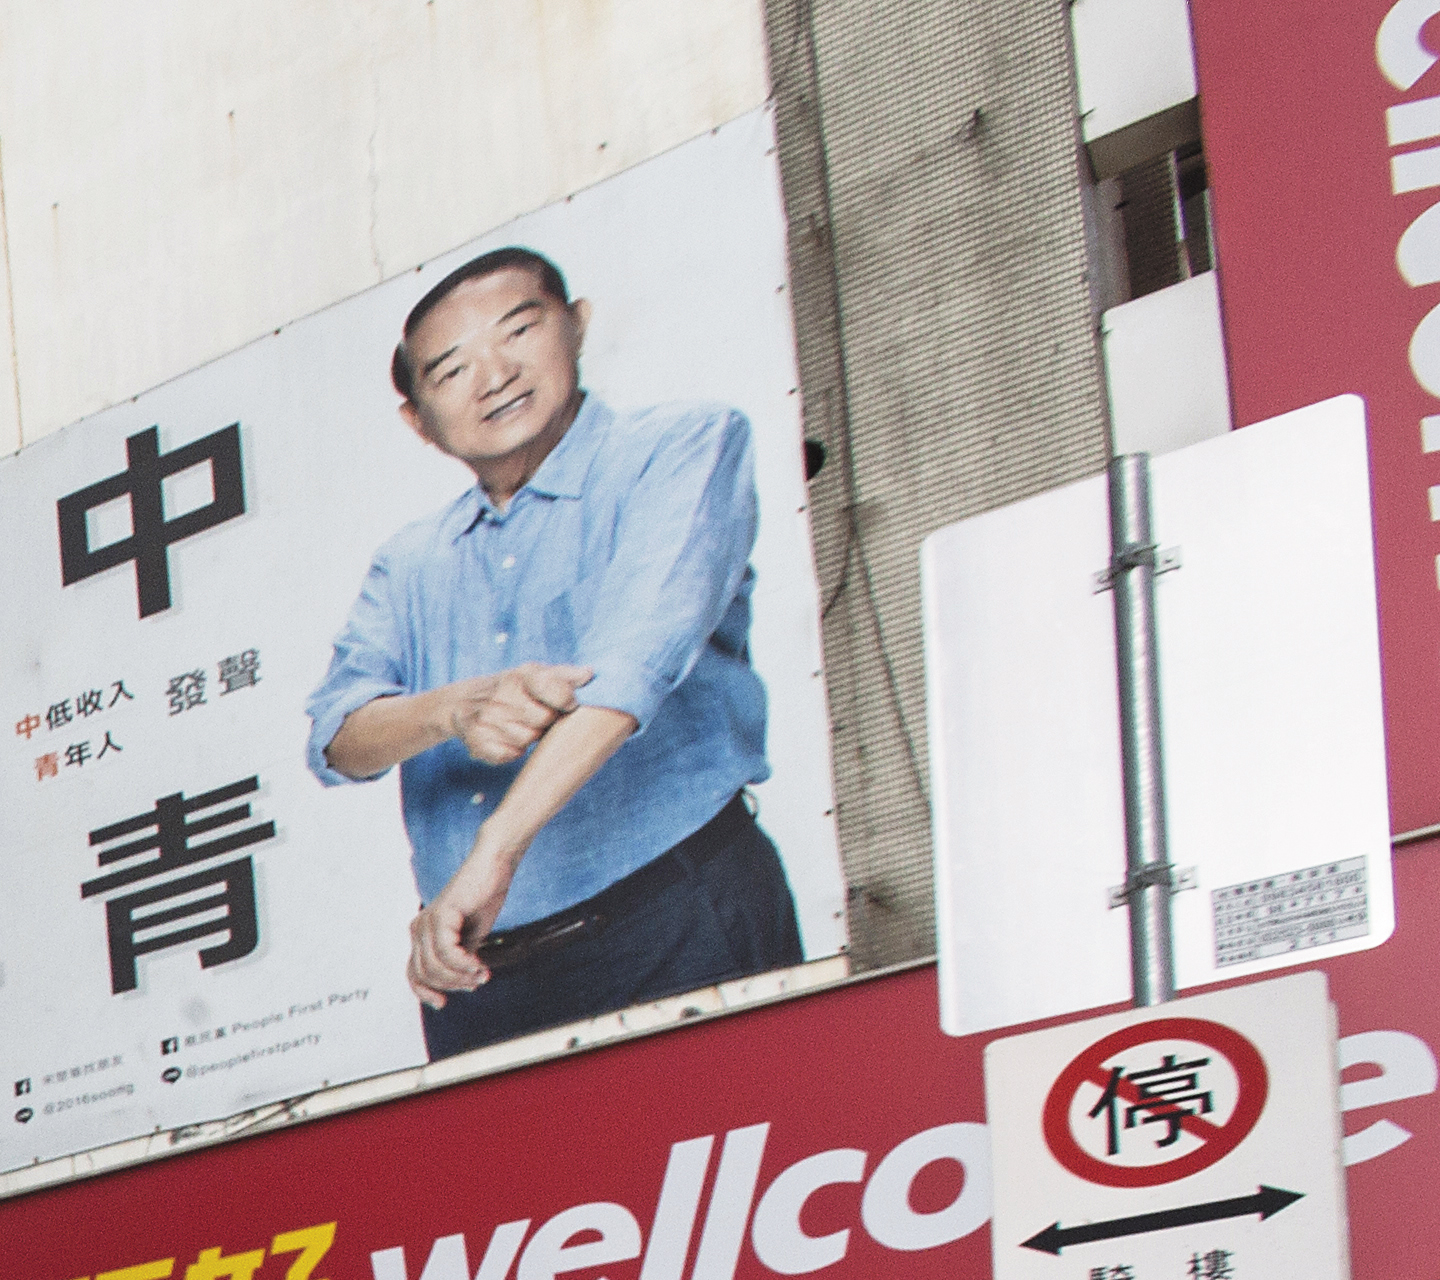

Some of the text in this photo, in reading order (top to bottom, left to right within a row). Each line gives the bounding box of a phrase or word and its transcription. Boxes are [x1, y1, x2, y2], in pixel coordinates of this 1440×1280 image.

[15, 680, 134, 739] 中低收入
[166, 648, 262, 716] 發聲
[34, 731, 123, 782] 青年人
[231, 1011, 283, 1036] People
[288, 1000, 323, 1018] First
[328, 988, 369, 1007] Party
[1089, 1053, 1217, 1156] 停
